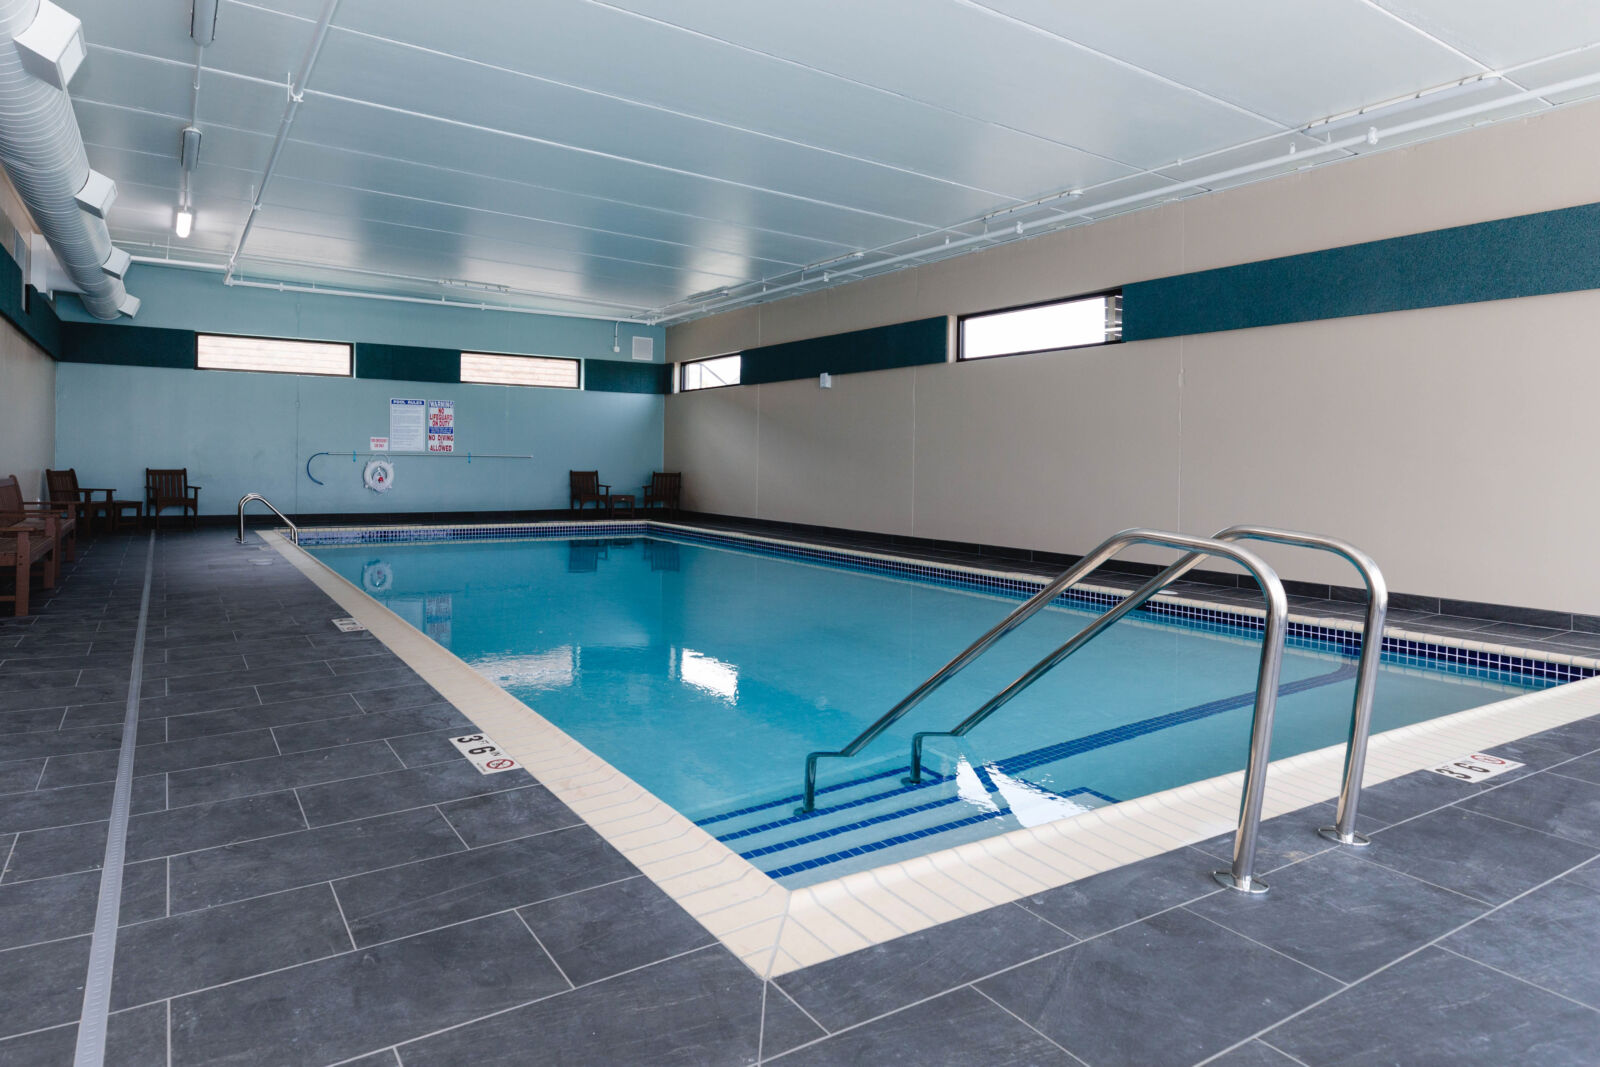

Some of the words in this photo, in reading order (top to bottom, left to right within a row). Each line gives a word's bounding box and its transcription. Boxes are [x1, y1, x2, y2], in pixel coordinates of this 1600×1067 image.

[457, 735, 483, 743] 3
[468, 746, 496, 754] 6
[1453, 762, 1491, 773] 6
[1435, 768, 1472, 779] 3
